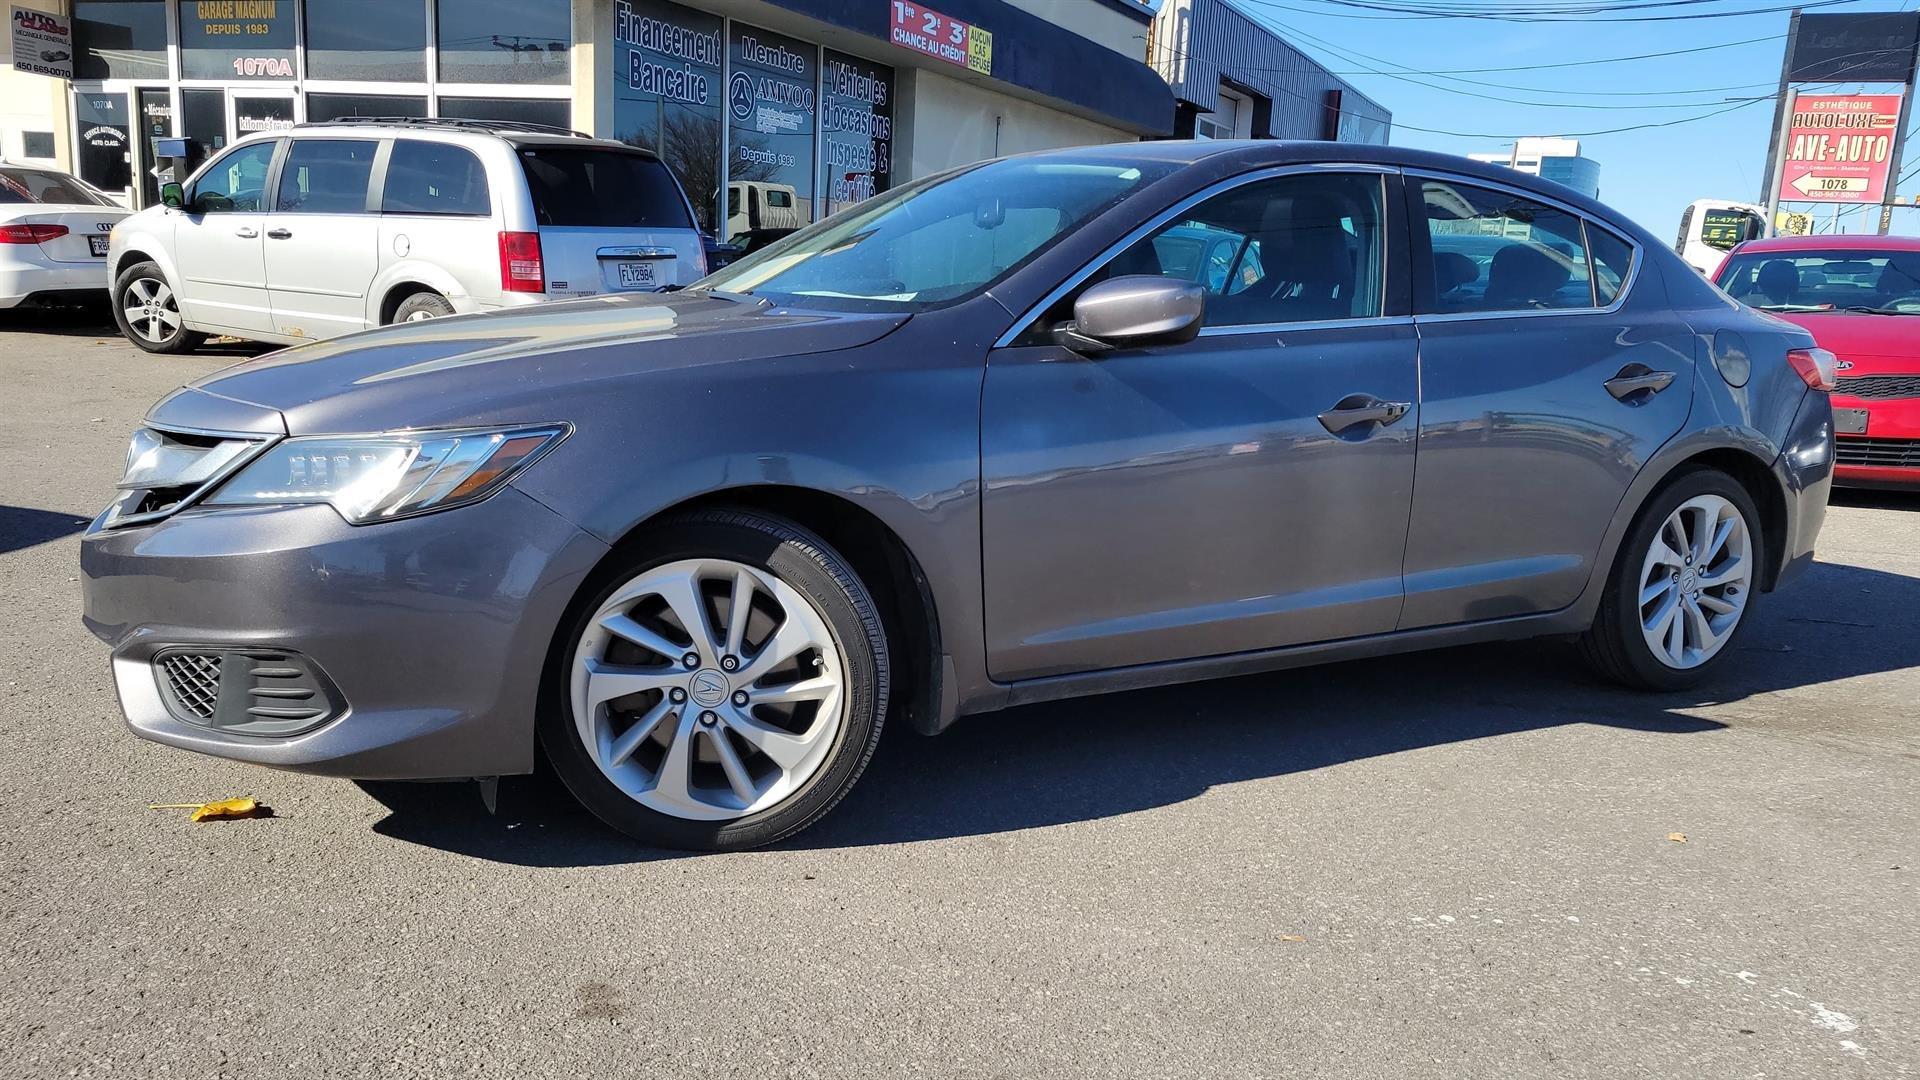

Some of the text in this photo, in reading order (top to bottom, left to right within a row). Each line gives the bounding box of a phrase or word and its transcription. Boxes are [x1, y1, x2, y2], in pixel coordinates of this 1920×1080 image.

[14, 10, 57, 27] AUTO
[198, 0, 276, 19] GARAGE MAGNUM
[206, 24, 269, 34] DEPUIS 1983
[615, 0, 720, 66] Financement
[970, 29, 991, 47] AUCUN
[742, 35, 805, 73] Membre
[893, 28, 966, 63] CHANCE AU CRÉDIT
[974, 44, 986, 57] CAS
[16, 61, 32, 71] 450
[233, 58, 293, 76] 1070A
[629, 49, 707, 104] Bancaire
[830, 60, 887, 106] Véhicules
[93, 100, 113, 109] 1070A
[756, 77, 815, 115] AMVOQ
[822, 96, 890, 140] d'occasions
[1792, 112, 1877, 129] AUTOLUXE
[740, 145, 796, 167] Depuis 1983
[826, 133, 888, 174] inspecté &
[1786, 134, 1889, 163] AVE-AUTO
[834, 175, 876, 204] certifié
[1821, 179, 1848, 190] 1078
[622, 269, 654, 282] FLY2984
